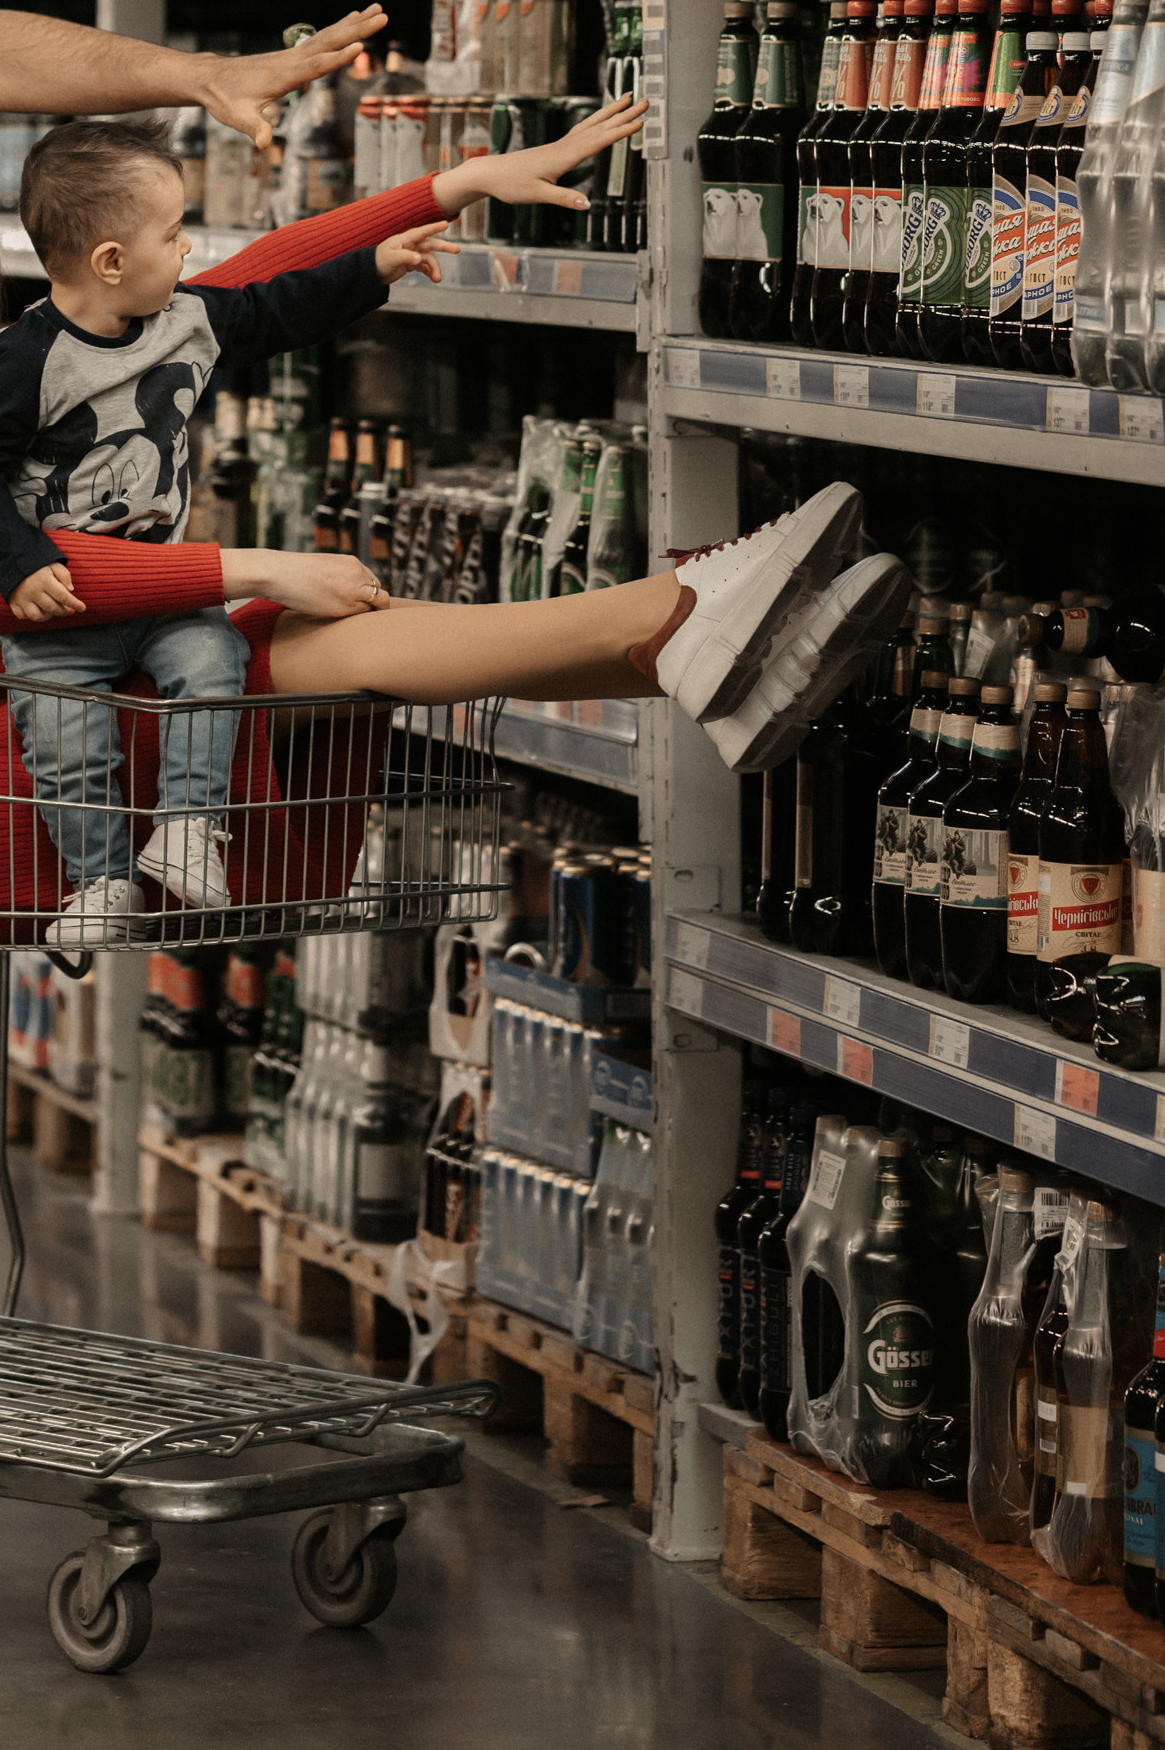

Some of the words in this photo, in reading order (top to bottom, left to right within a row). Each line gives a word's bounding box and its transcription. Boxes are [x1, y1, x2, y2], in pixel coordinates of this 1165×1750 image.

[1029, 273, 1046, 283] ГОСТ
[1024, 286, 1053, 300] АРНОЕ
[867, 1338, 933, 1376] Gösse
[892, 1378, 919, 1388] BIER
